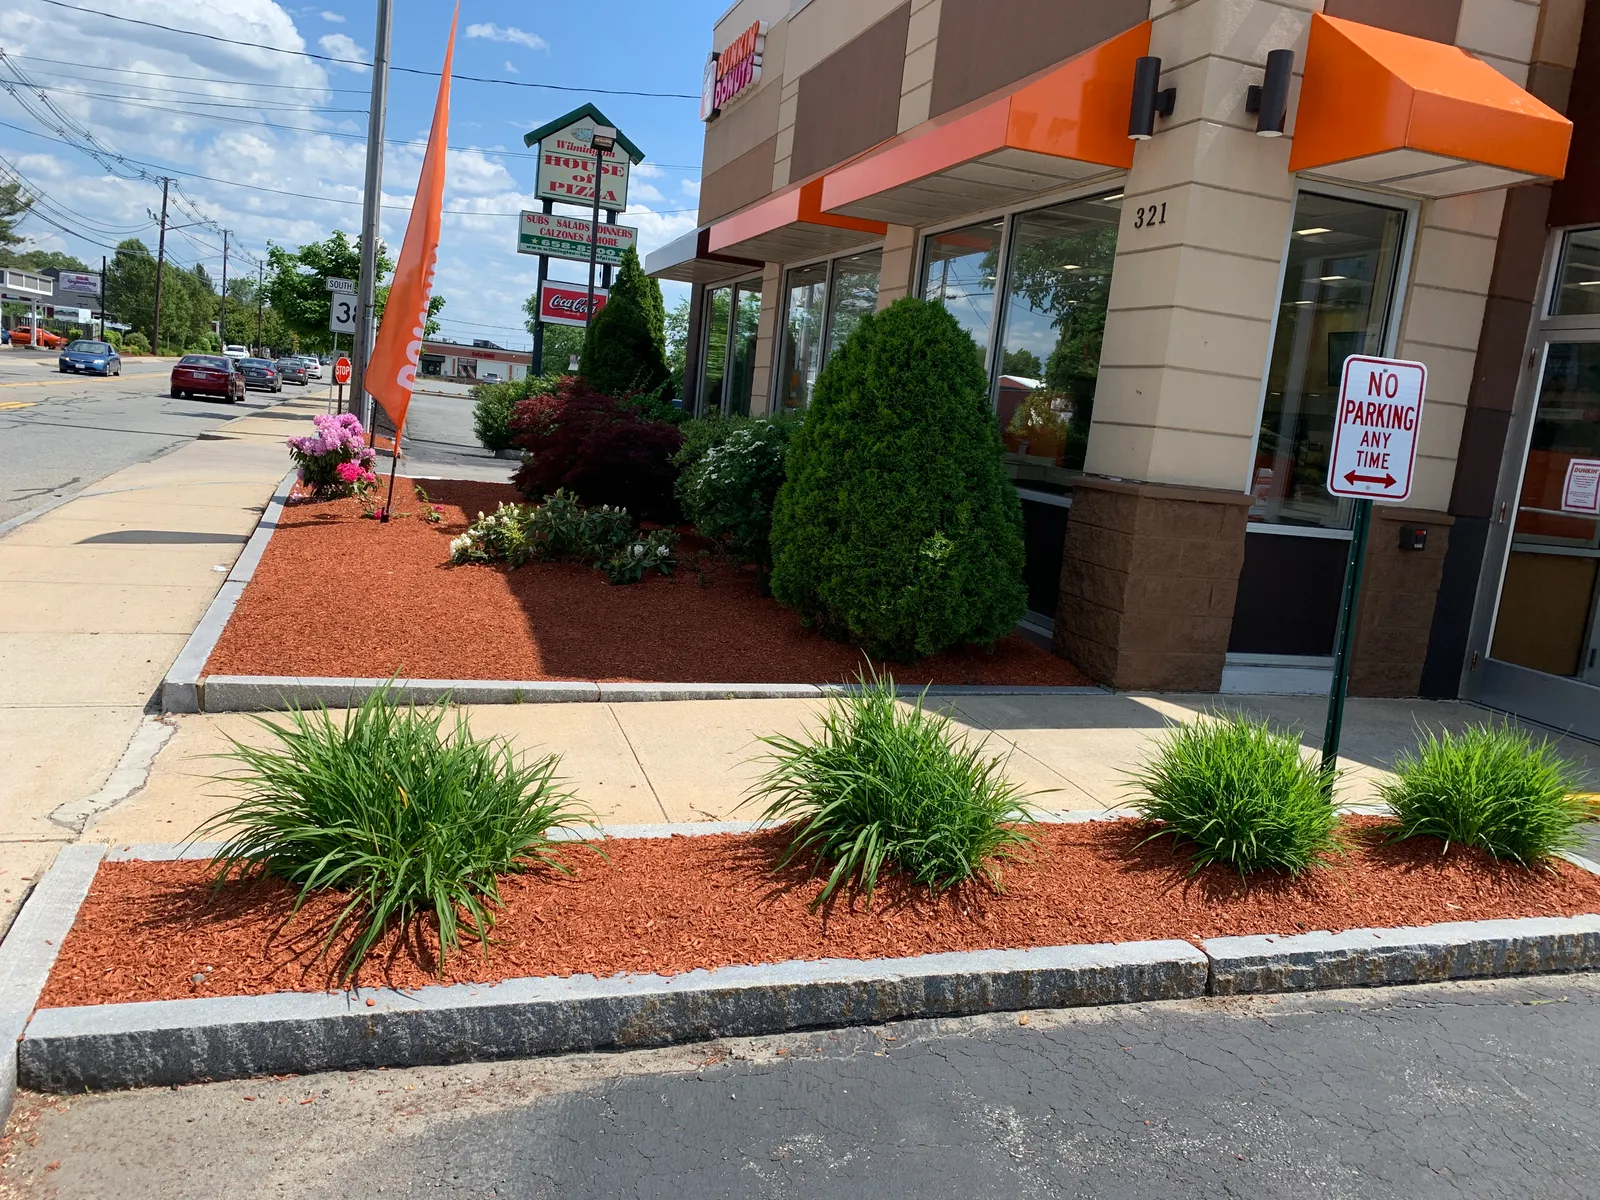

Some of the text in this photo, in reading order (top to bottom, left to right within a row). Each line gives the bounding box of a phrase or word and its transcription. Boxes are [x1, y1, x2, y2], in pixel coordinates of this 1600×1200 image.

[714, 53, 754, 109] DONUTS
[557, 140, 616, 158] Wilmingon
[544, 154, 625, 178] HOUSE
[572, 174, 596, 184] of
[1134, 202, 1167, 229] 321
[526, 214, 633, 239] SUBS SALADS DINNERS
[540, 227, 584, 241] CALZONES
[586, 234, 592, 243] &
[329, 280, 353, 291] SOUTH
[549, 294, 600, 314] Coca-Coa
[335, 366, 351, 376] STOP
[1368, 371, 1399, 399] NO
[1343, 400, 1415, 431] PARKING
[1360, 430, 1392, 449] ANY
[1356, 450, 1391, 470] TIME
